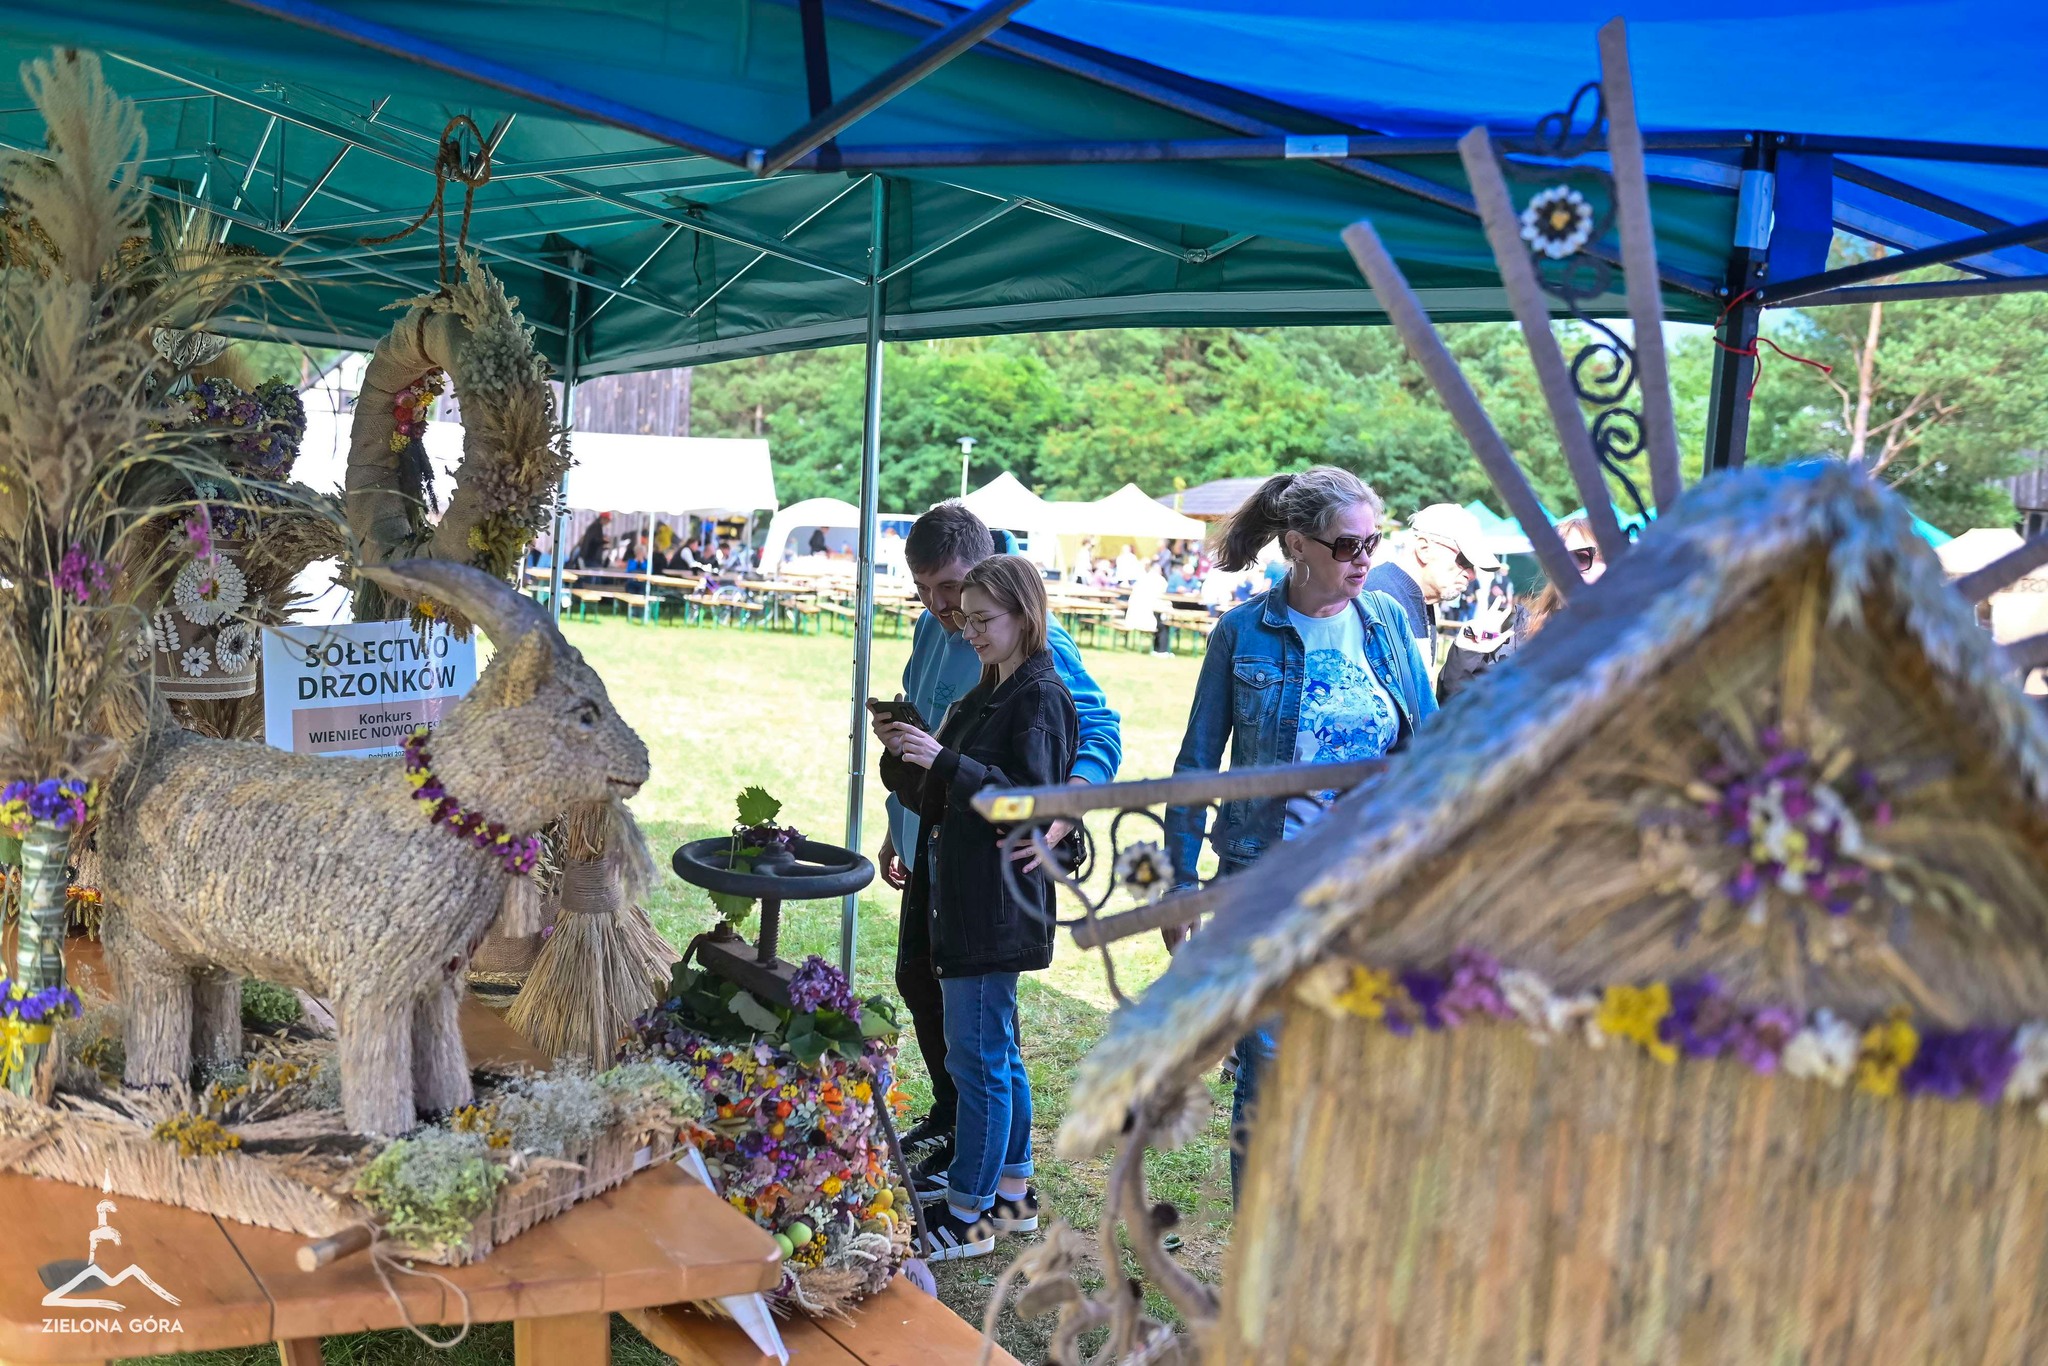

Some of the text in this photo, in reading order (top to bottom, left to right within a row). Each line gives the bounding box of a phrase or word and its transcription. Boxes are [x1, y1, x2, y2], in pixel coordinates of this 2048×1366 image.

[305, 635, 449, 668] SOŁECTWO
[298, 662, 457, 700] DRZONKÓW
[359, 711, 412, 725] Konkurs
[308, 728, 367, 744] WIENIEC
